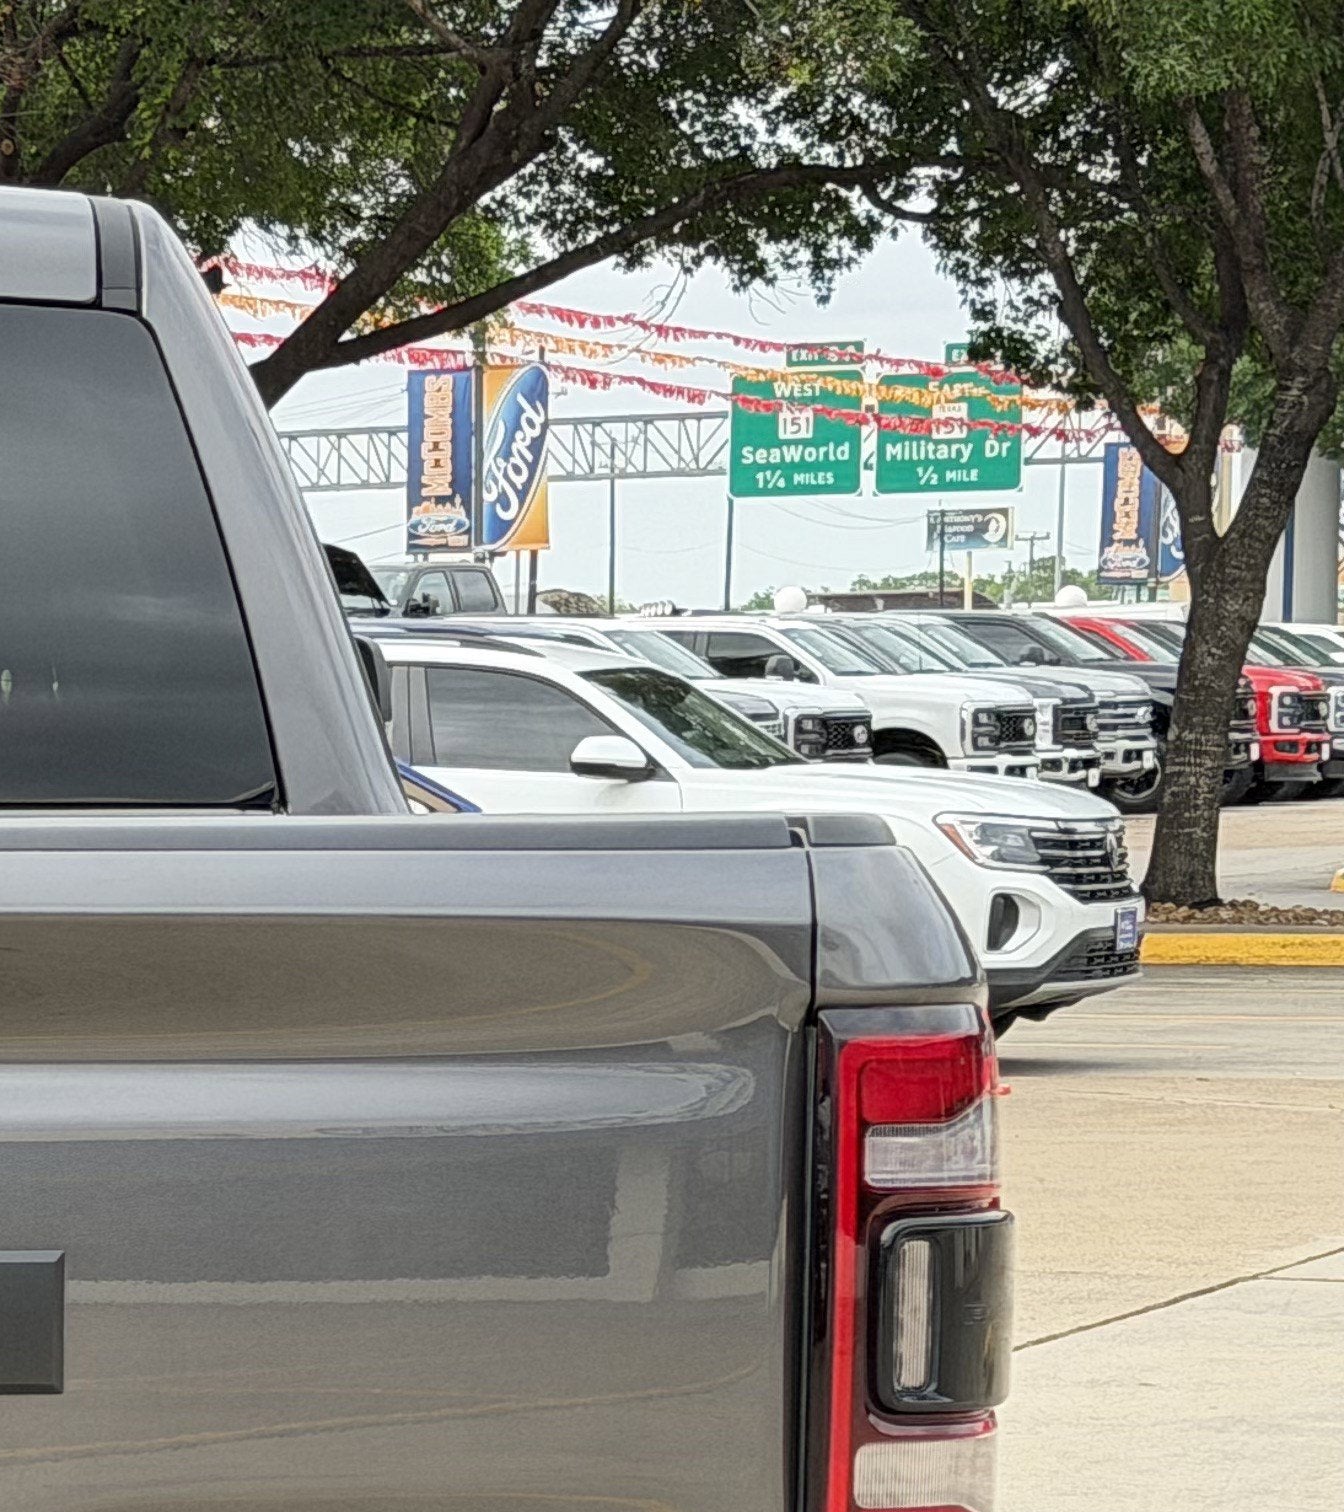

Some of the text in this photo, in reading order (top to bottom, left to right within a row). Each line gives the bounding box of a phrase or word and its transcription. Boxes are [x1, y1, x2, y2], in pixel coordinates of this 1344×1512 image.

[772, 380, 822, 398] WEST
[783, 416, 810, 436] 151
[483, 392, 545, 521] Ford
[741, 441, 850, 465] SeaWorld
[885, 440, 1011, 463] Military Dr
[793, 471, 835, 486] MILES
[945, 468, 979, 483] MILE
